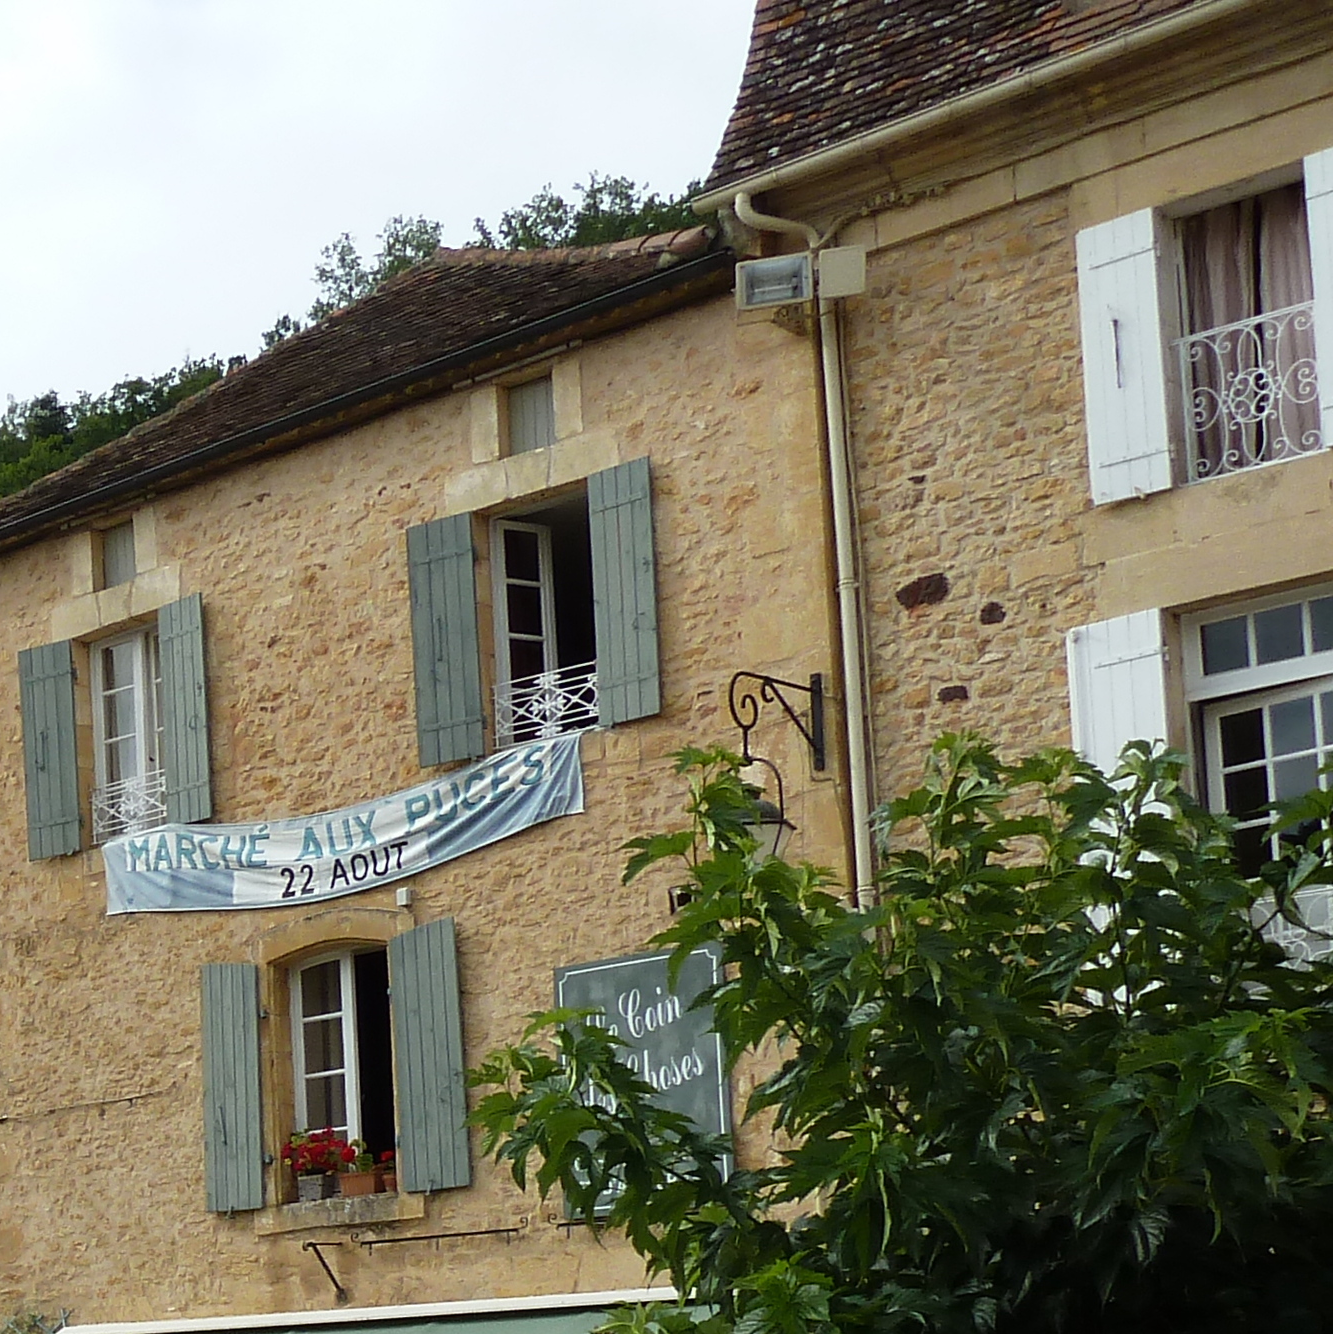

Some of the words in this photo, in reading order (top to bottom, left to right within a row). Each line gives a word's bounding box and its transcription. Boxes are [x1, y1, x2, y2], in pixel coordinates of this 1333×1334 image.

[126, 825, 271, 873] MARCHÉ
[296, 810, 378, 863] AUX
[404, 745, 547, 833] PUCES
[280, 864, 316, 899] 22
[329, 841, 409, 889] AOUT
[618, 986, 683, 1039] Coin
